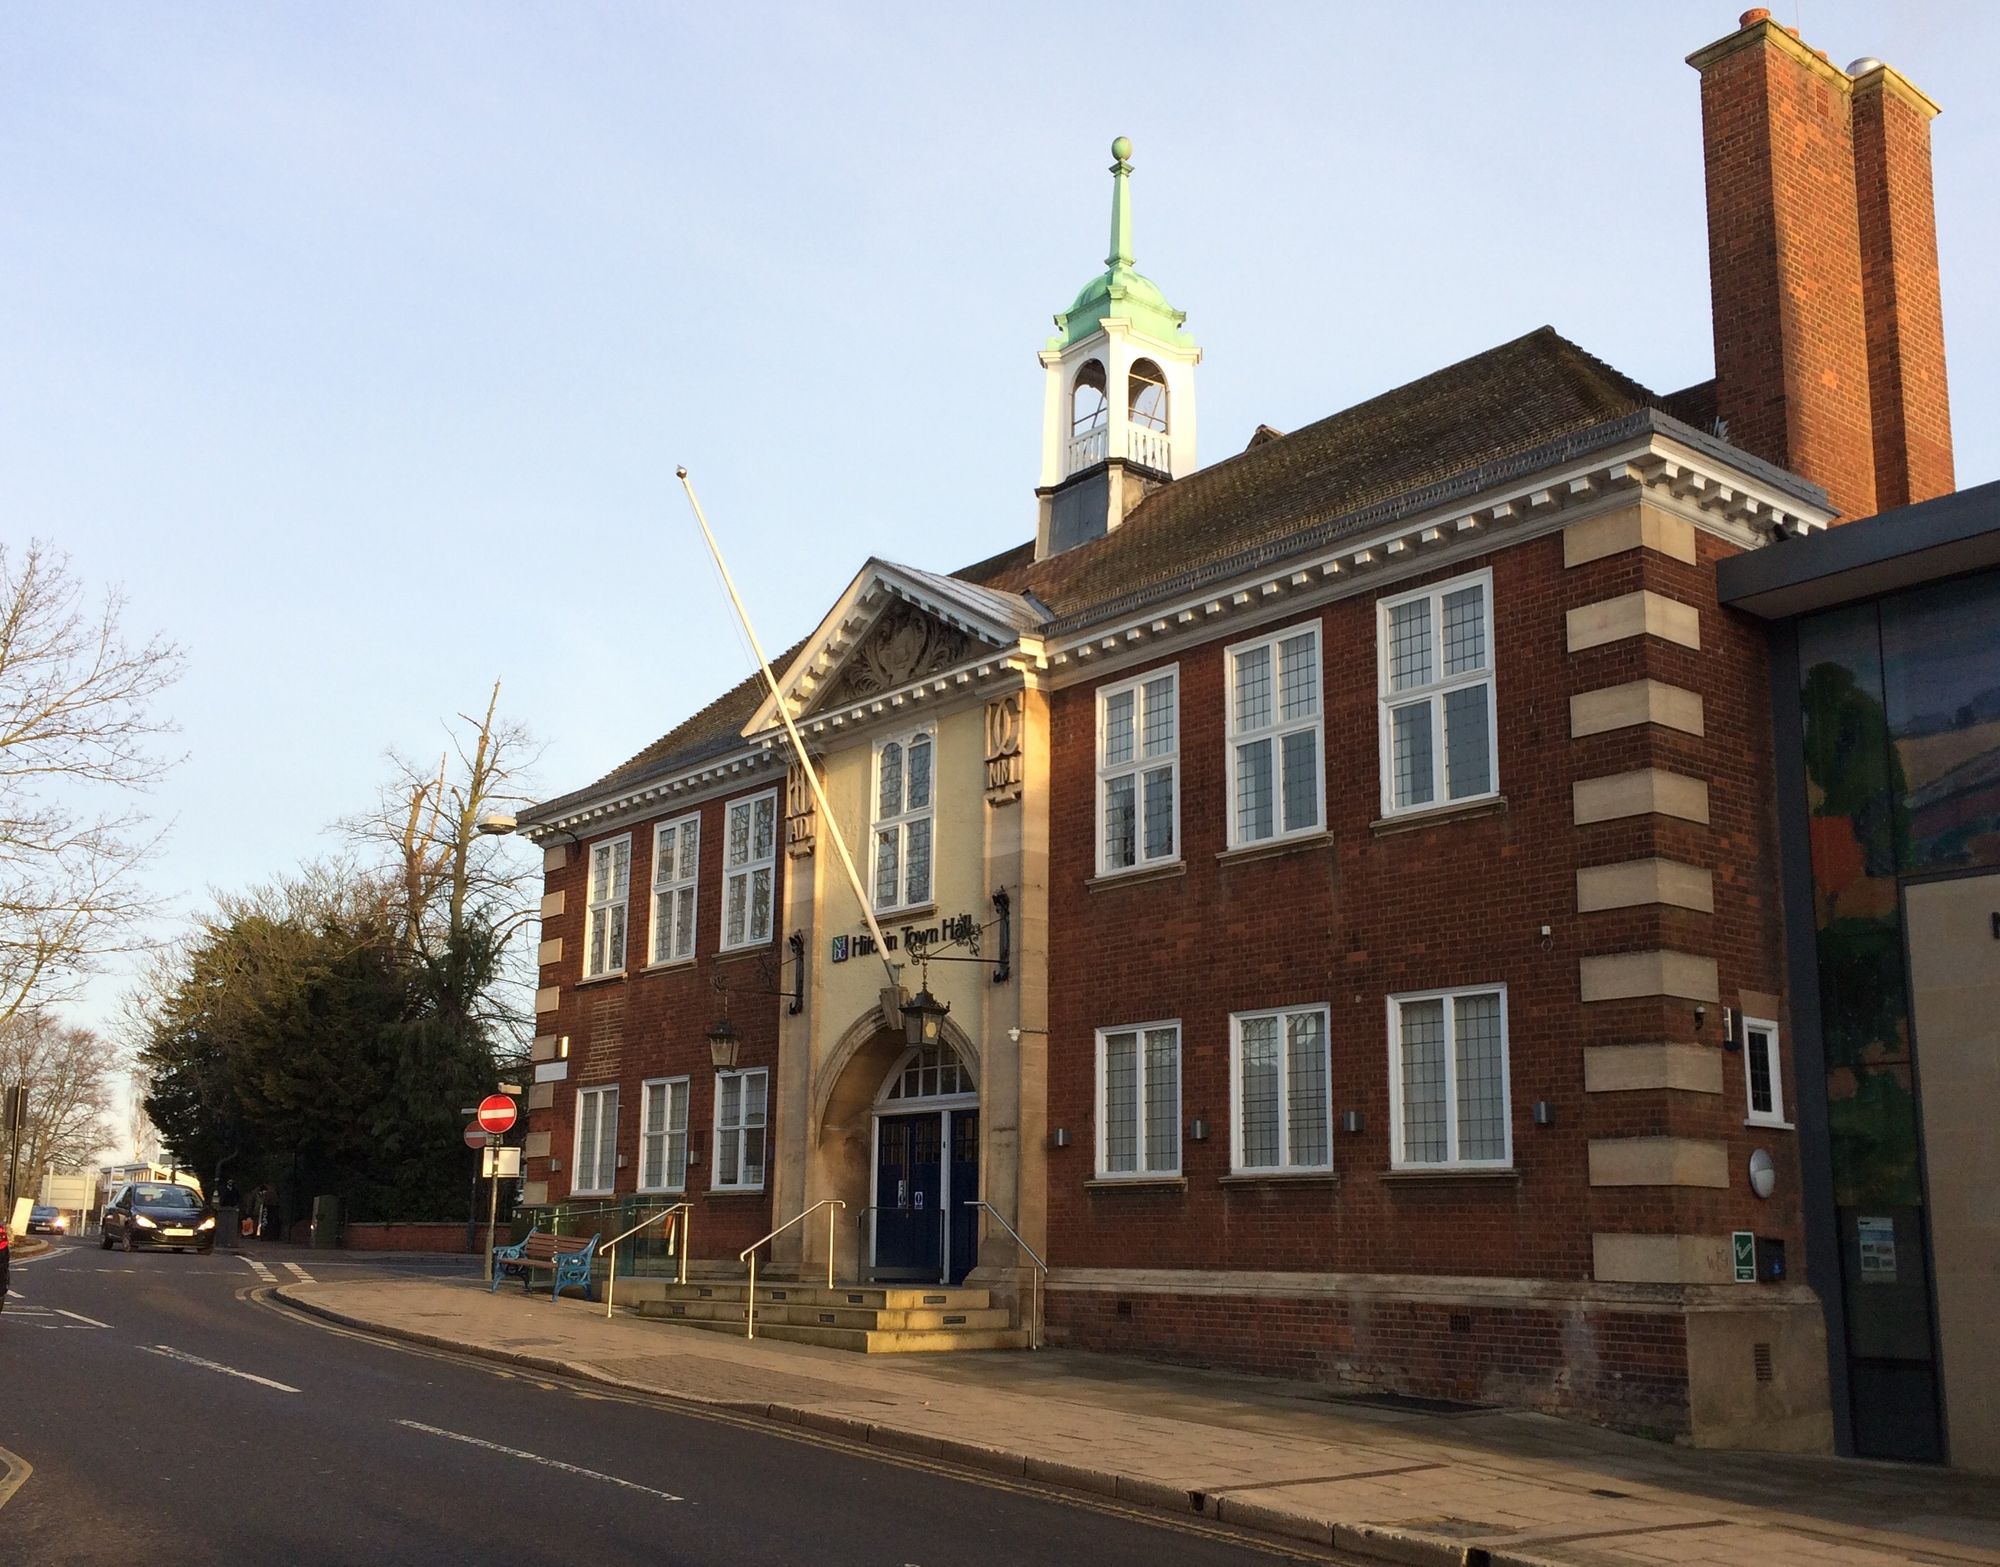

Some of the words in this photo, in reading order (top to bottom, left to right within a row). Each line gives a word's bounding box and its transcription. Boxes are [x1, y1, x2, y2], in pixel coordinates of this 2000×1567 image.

[852, 931, 897, 957] Hitcin
[901, 926, 939, 949] Town
[942, 914, 971, 941] Hall
